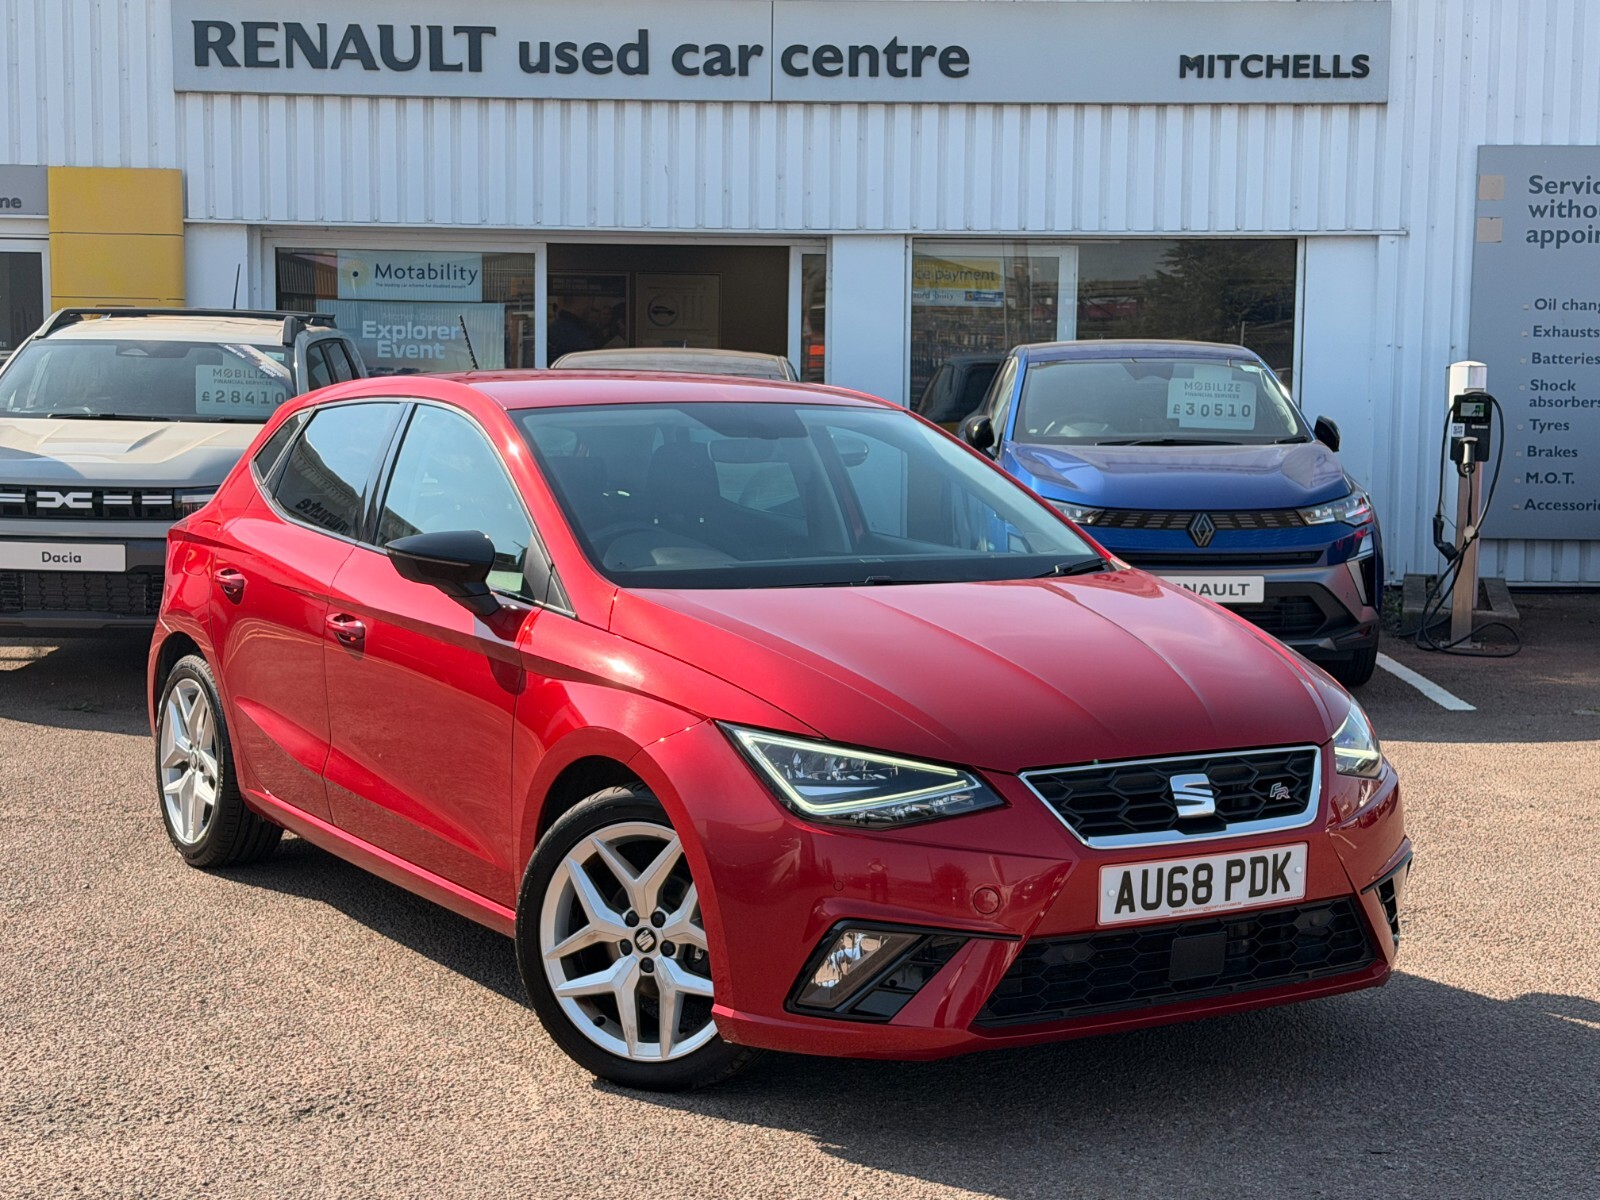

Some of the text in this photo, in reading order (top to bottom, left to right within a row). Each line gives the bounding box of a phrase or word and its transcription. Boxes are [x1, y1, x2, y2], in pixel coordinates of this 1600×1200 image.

[191, 19, 970, 78] RENAULT used car centre
[1179, 53, 1371, 79] MITCHELLS
[1528, 198, 1600, 218] witho
[374, 262, 478, 286] Motability
[935, 270, 996, 282] payment
[1534, 298, 1600, 314] Oil chan
[362, 320, 460, 342] Explorer
[1533, 325, 1600, 338] Exhausts
[377, 340, 446, 359] Event
[1532, 352, 1600, 365] Batteries
[1529, 379, 1577, 391] Shock
[1529, 418, 1570, 434] Tyres
[1527, 445, 1578, 457] Brakes
[1525, 471, 1575, 485] M.O.T.
[1523, 498, 1600, 511] Accessori
[41, 551, 82, 564] Dacia
[1176, 583, 1251, 597] NAULT
[1114, 851, 1292, 915] AU68 PDK
